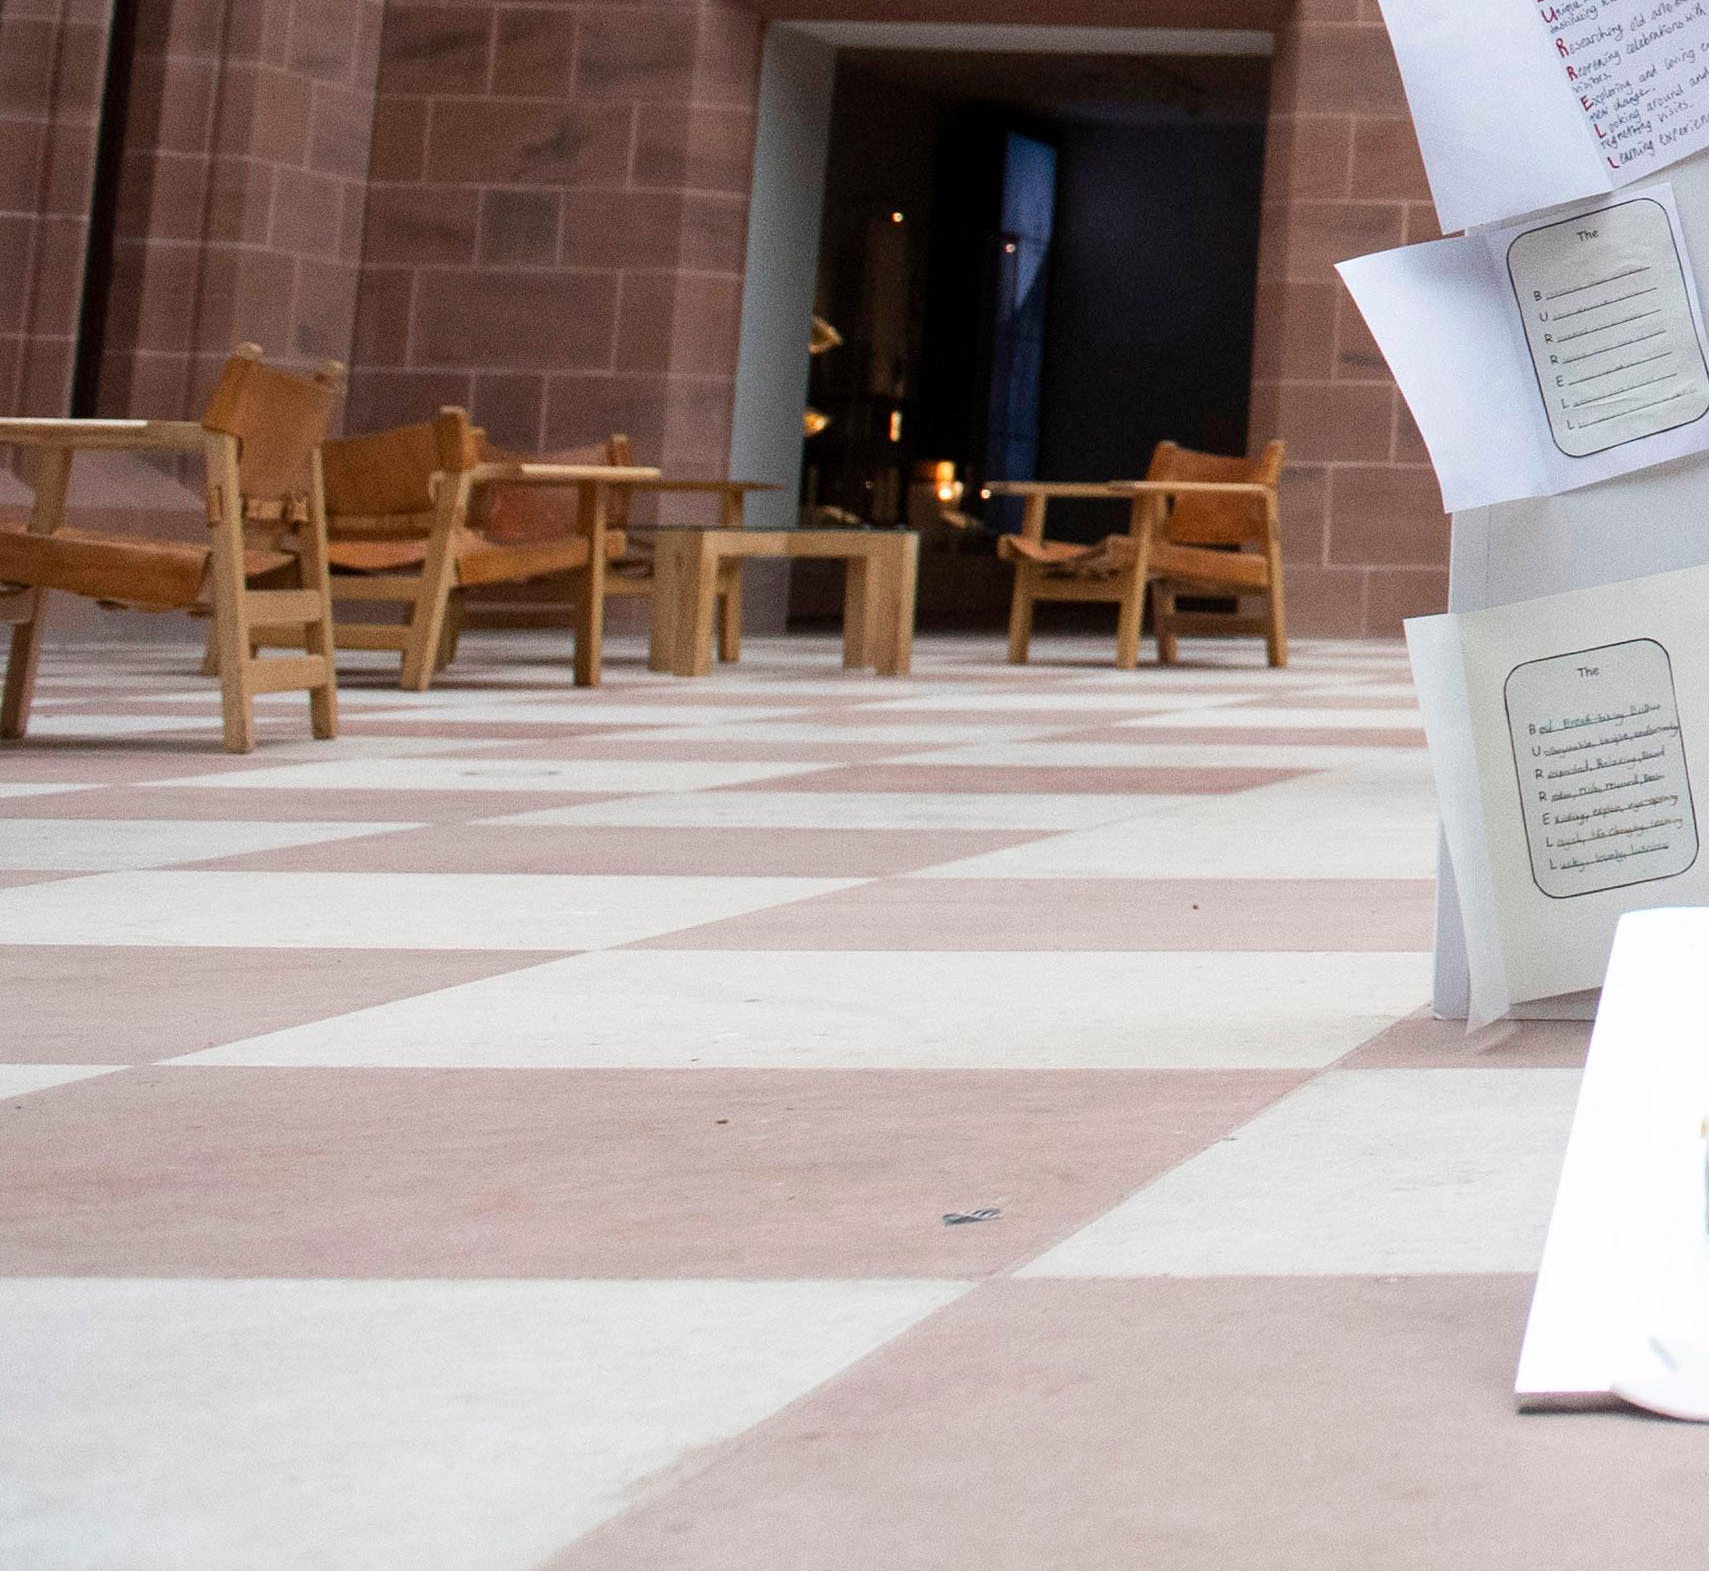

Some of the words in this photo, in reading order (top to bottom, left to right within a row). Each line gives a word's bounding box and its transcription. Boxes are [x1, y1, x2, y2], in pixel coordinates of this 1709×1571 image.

[1555, 24, 1623, 58] Researching
[1629, 13, 1645, 31] old
[1579, 80, 1631, 111] Exploring
[1639, 64, 1656, 82] and
[1664, 47, 1695, 70] loving
[1646, 83, 1683, 111] around
[1689, 66, 1709, 86] and
[1606, 140, 1654, 169] Learning
[1577, 229, 1599, 242] The
[1577, 665, 1600, 677] The
